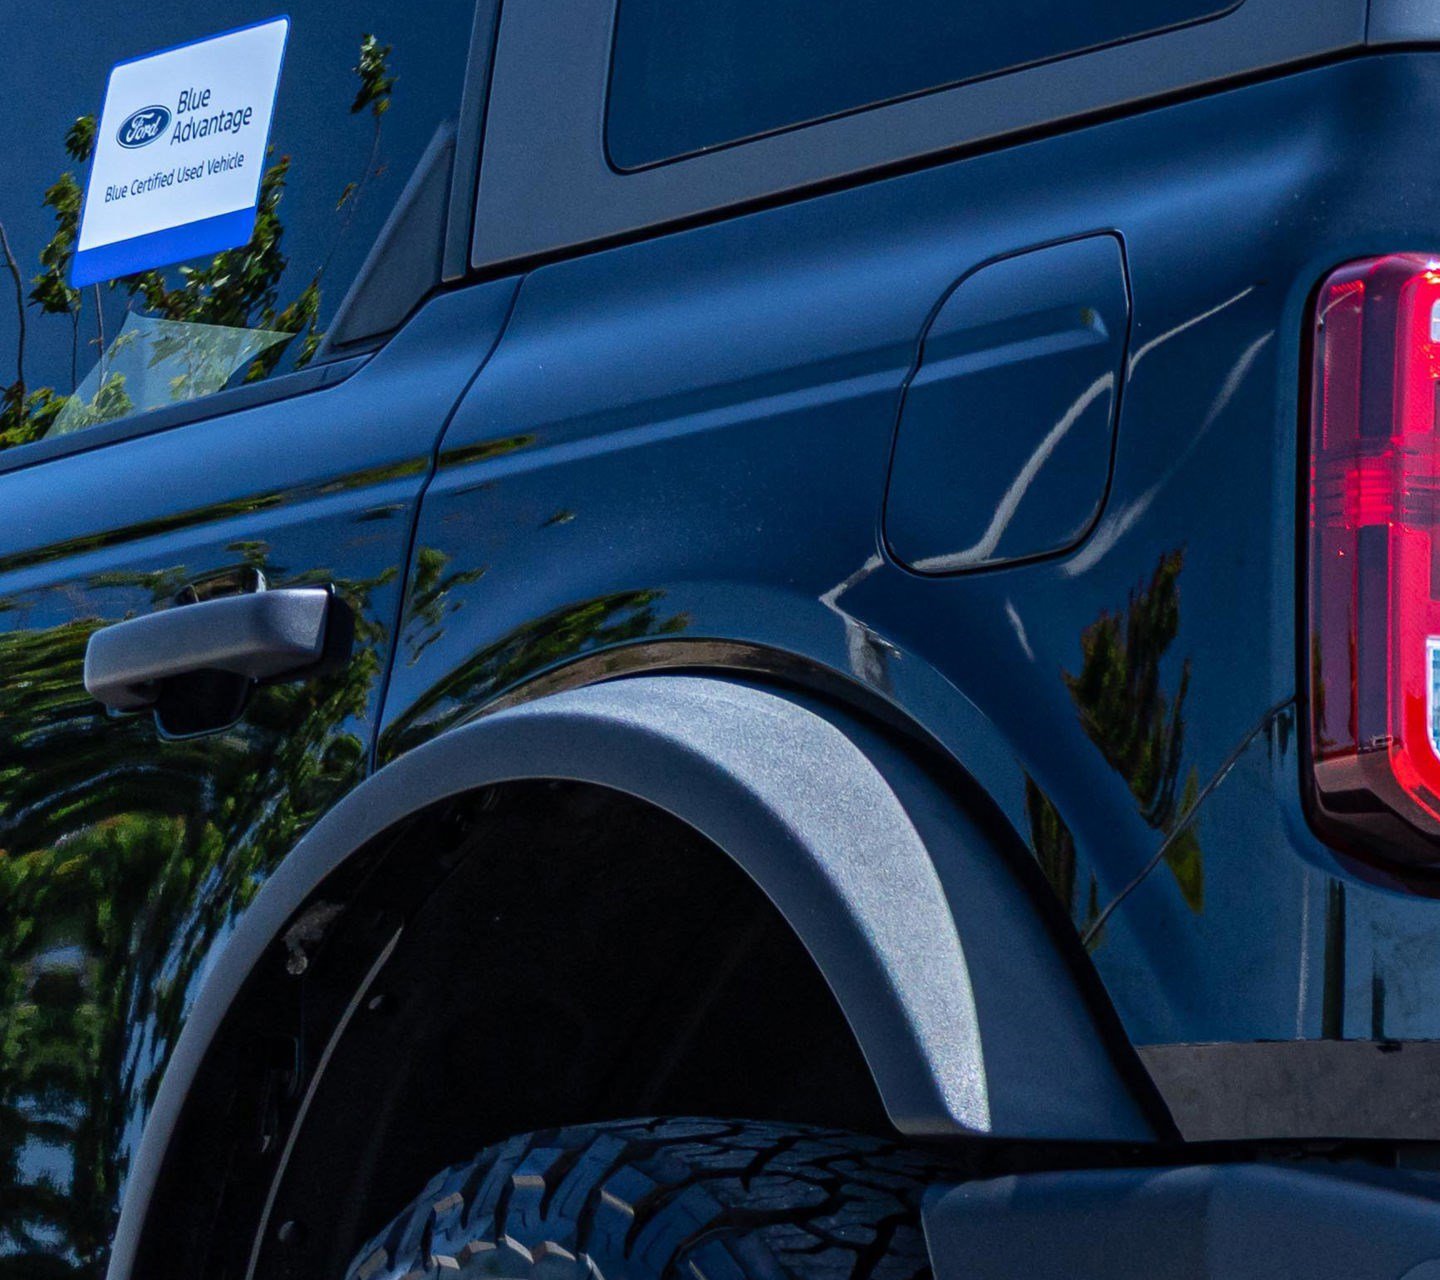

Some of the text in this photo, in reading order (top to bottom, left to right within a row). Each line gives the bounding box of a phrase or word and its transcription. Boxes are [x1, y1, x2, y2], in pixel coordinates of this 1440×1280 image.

[177, 86, 211, 114] Blue
[124, 112, 163, 142] Ford
[170, 105, 253, 146] Advantage
[104, 151, 245, 203] Blue Certified Used Vehicle
